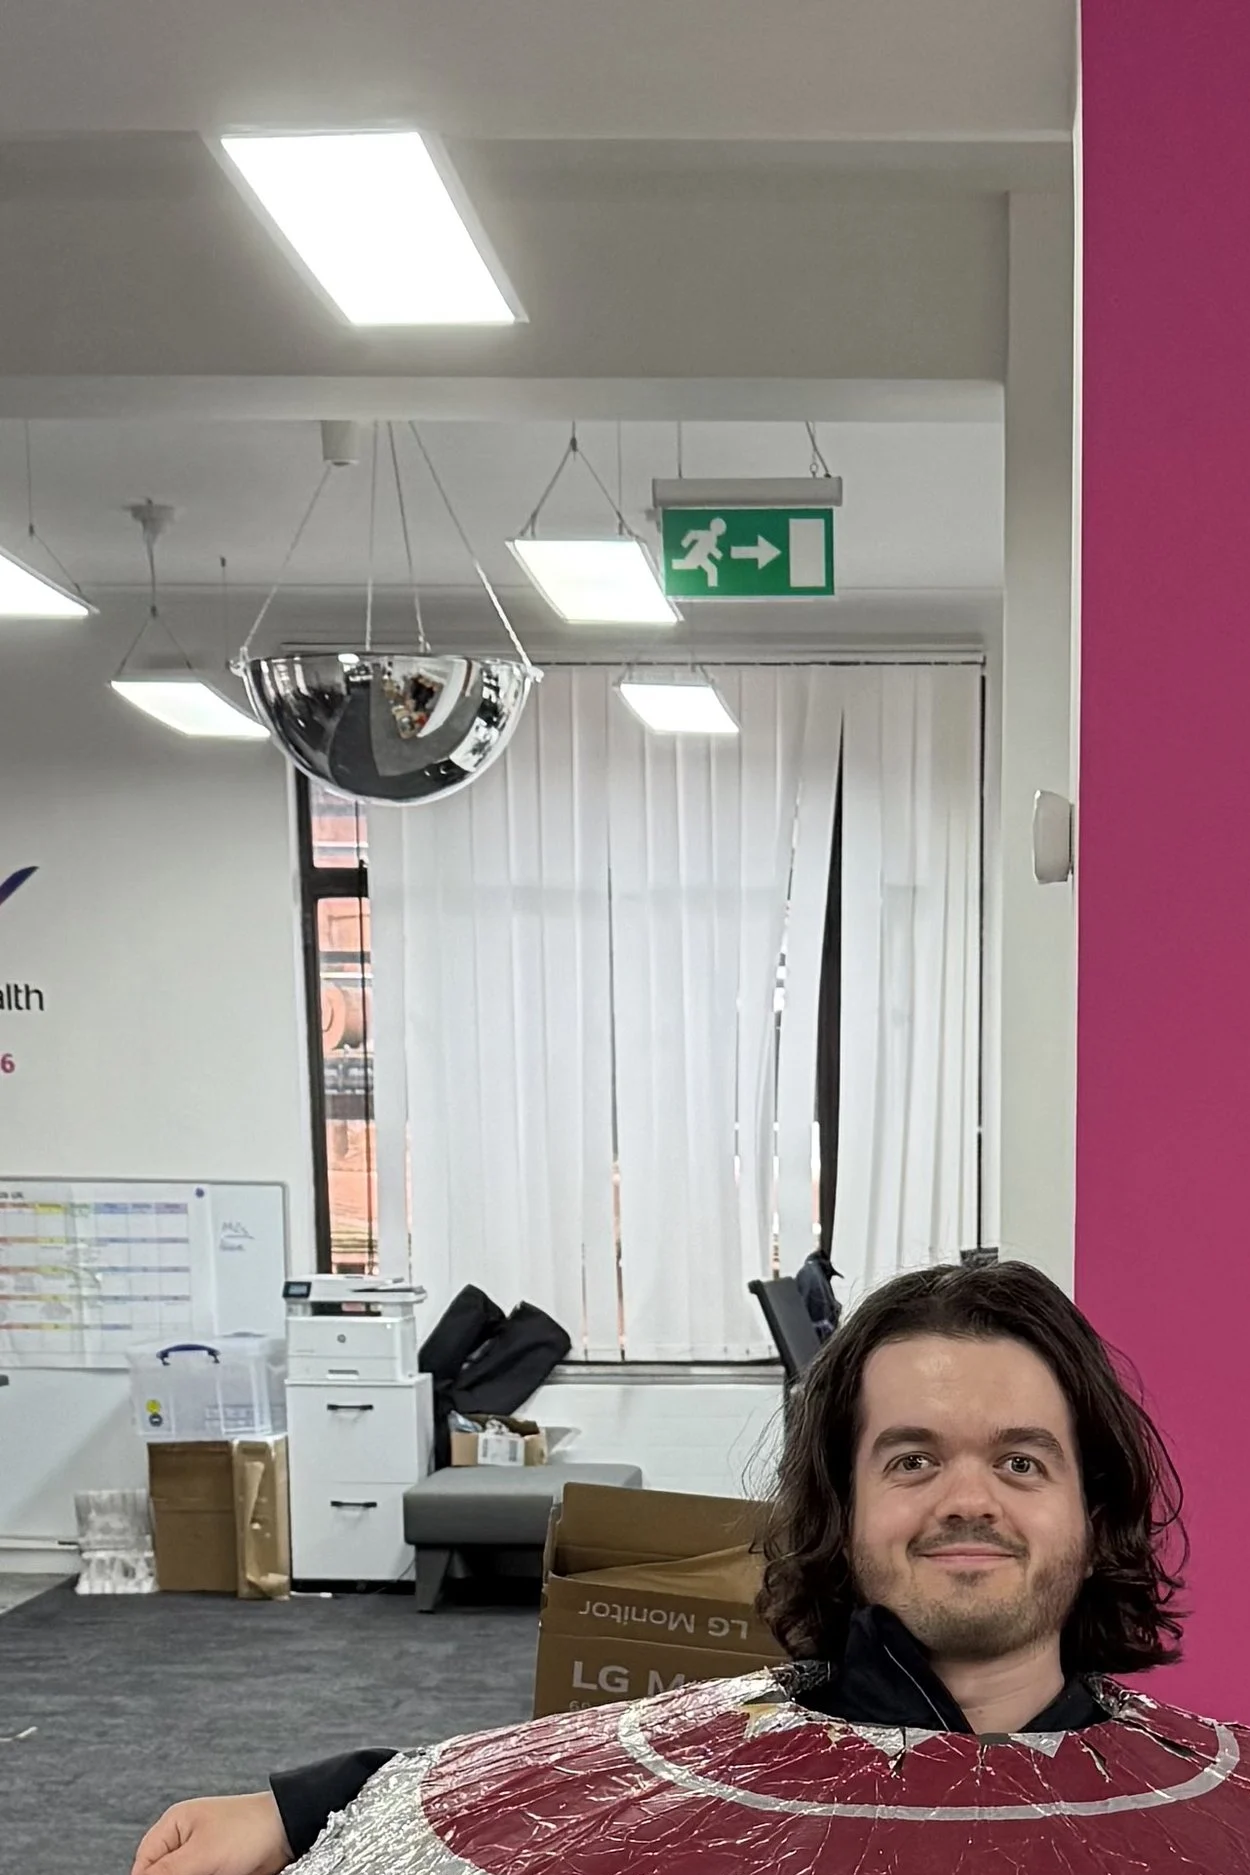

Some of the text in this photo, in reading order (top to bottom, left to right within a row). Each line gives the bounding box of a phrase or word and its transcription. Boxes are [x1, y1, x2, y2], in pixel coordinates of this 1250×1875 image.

[577, 1600, 749, 1641] LG Monitor
[571, 1660, 631, 1693] LG
